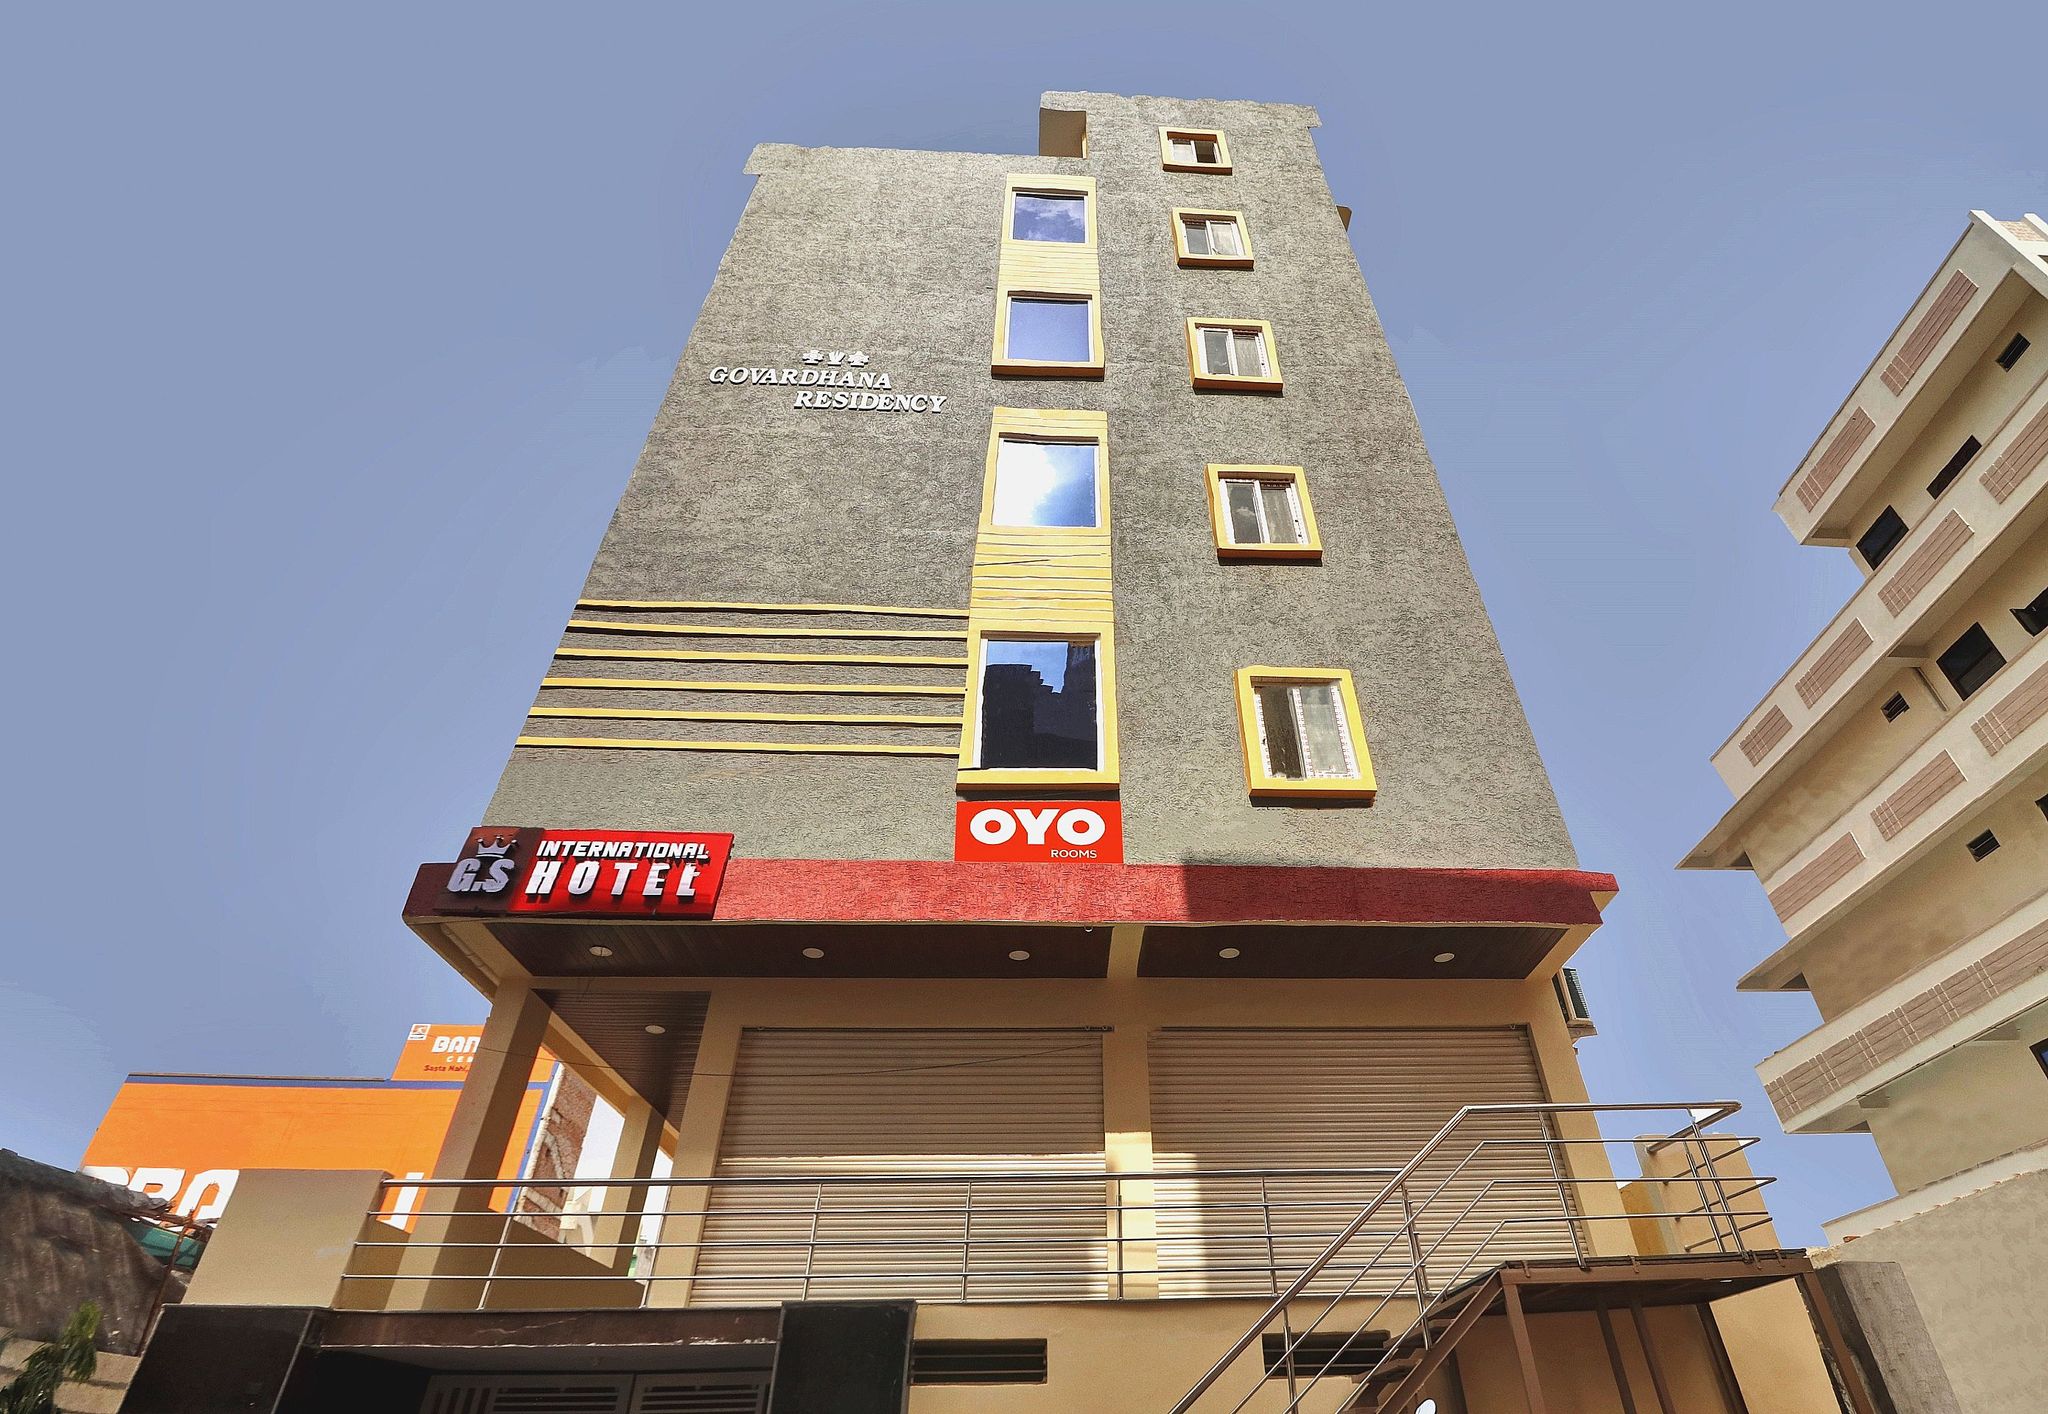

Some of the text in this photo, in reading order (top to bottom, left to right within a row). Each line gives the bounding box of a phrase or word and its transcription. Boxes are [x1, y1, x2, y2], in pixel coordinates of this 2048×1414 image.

[709, 366, 892, 390] GOVARDHANA
[794, 391, 947, 413] RESIDENCY
[969, 808, 1106, 846] OYO
[536, 840, 709, 860] INTERNATIONAL
[1050, 849, 1097, 859] ROOMS
[525, 860, 701, 897] HOTEL
